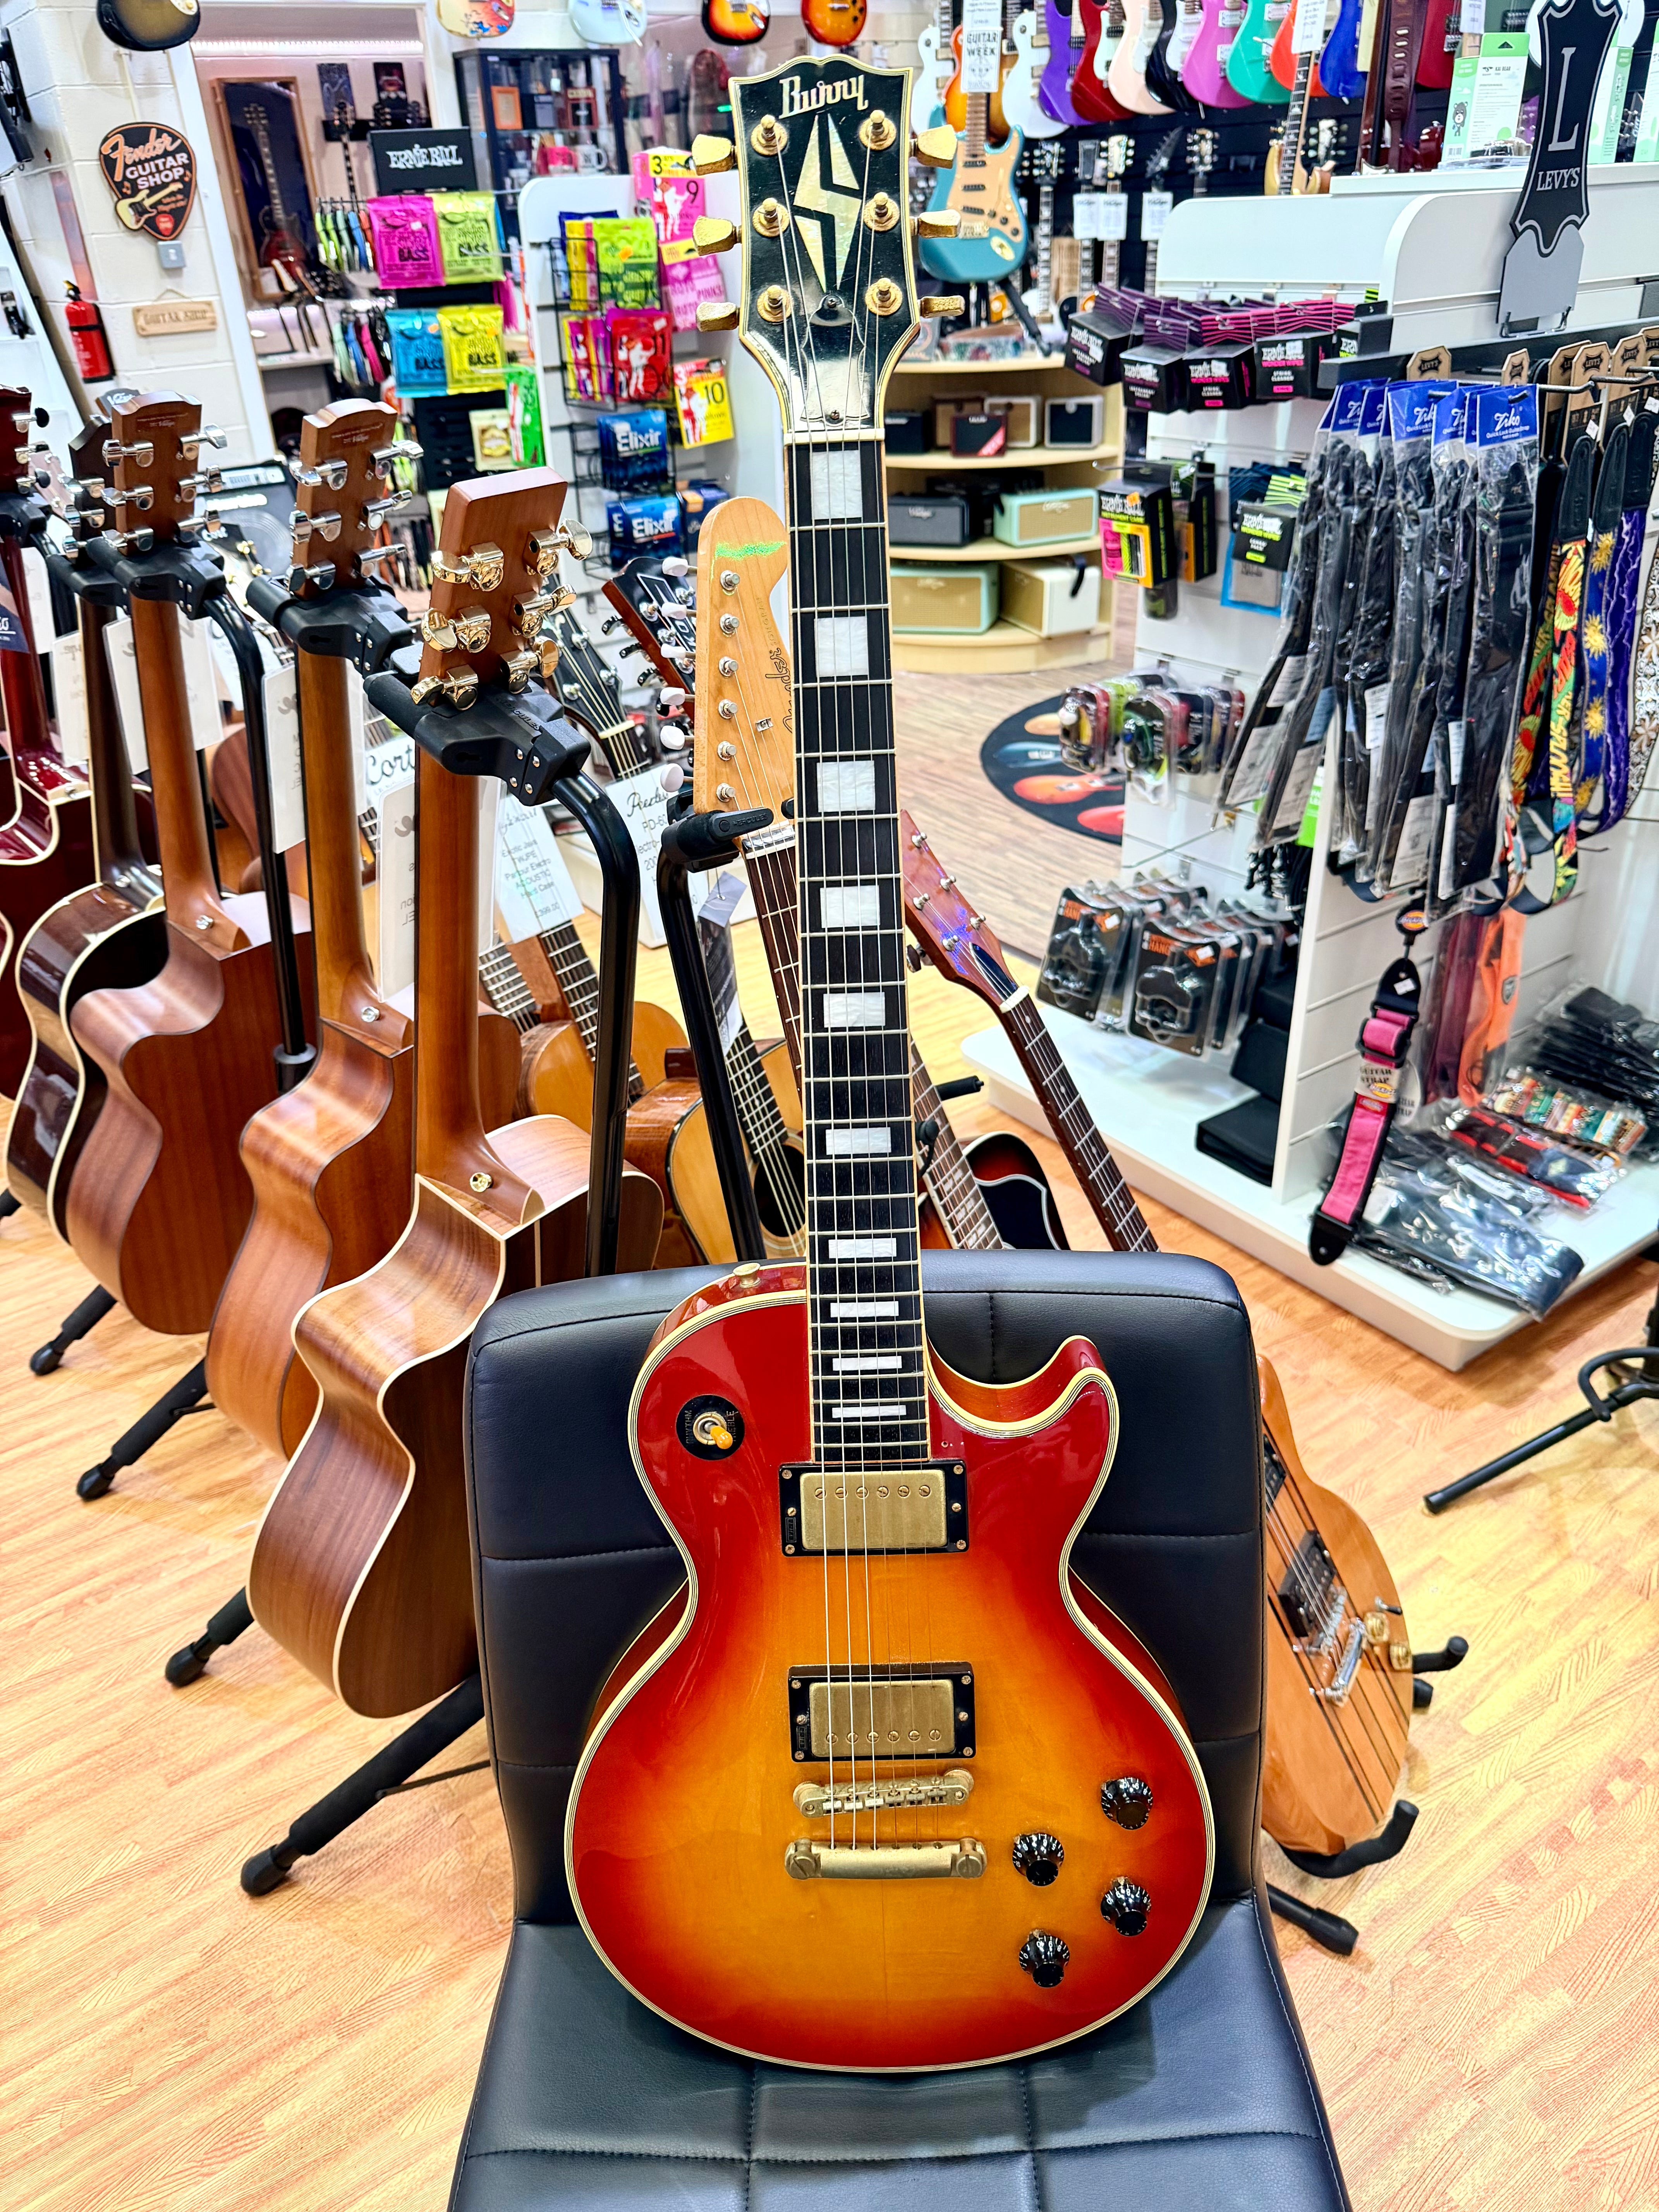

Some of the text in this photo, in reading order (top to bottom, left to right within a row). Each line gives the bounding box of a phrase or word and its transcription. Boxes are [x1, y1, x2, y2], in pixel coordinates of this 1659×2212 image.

[967, 48, 995, 57] WEEK
[779, 75, 868, 119] Burny
[101, 128, 182, 182] Fender
[125, 153, 189, 179] GUITAR
[386, 144, 463, 169] ERNIE BALL
[653, 156, 662, 175] 3
[137, 167, 184, 189] SHOP
[1536, 167, 1580, 191] LEVY'S
[687, 180, 699, 204] 9
[705, 382, 724, 405] 10
[617, 429, 661, 452] Elixir
[632, 517, 673, 538] Elixir
[367, 744, 415, 785] Cort
[635, 840, 660, 856] lectro-
